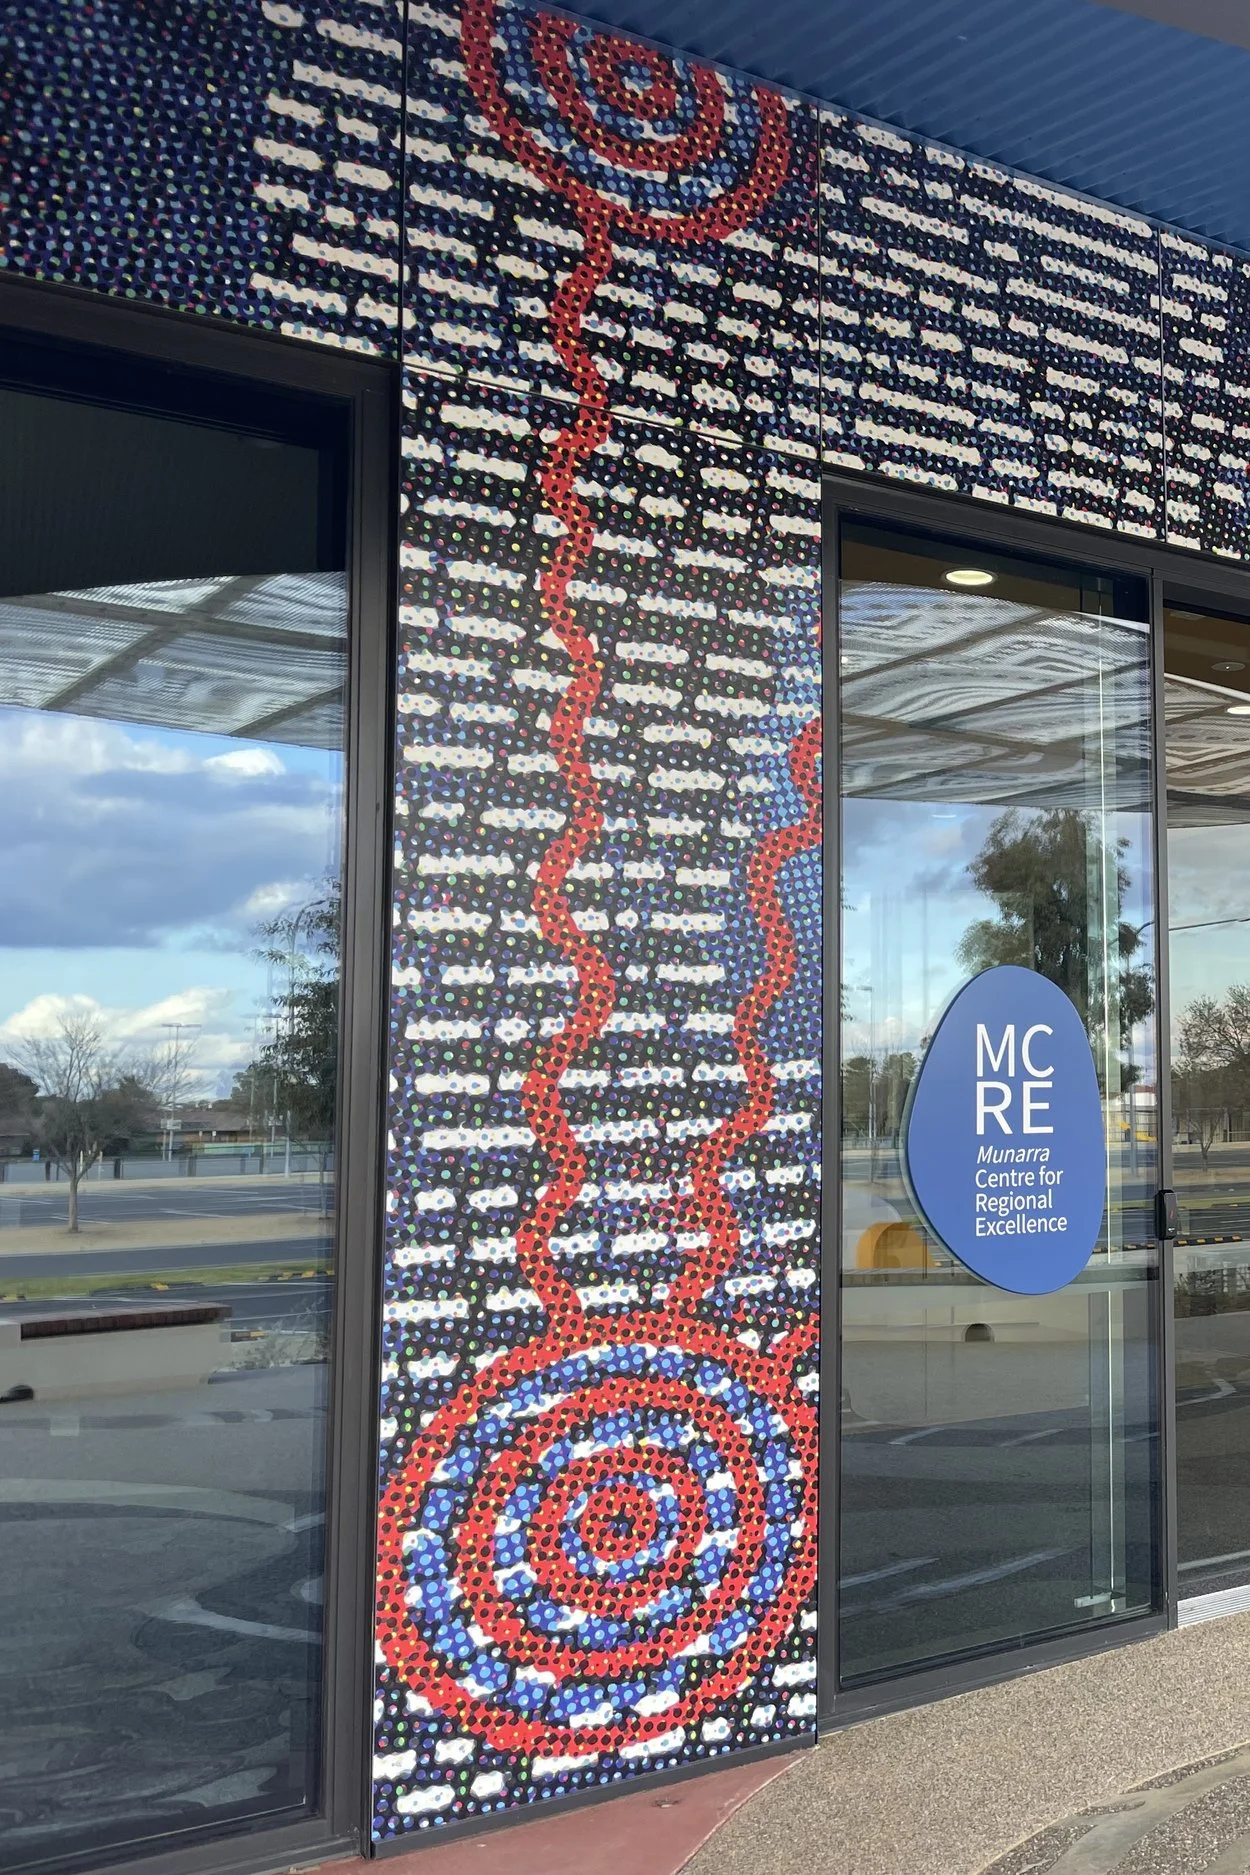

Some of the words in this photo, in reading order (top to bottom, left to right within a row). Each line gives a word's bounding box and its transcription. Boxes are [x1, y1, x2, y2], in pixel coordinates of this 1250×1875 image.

[976, 1023, 1055, 1078] MC
[976, 1080, 1054, 1136] RE
[976, 1146, 1050, 1164] Munarra
[975, 1168, 1035, 1188] Centre
[1038, 1166, 1063, 1187] for
[975, 1188, 1052, 1217] Regional
[975, 1214, 1068, 1237] Excellence
